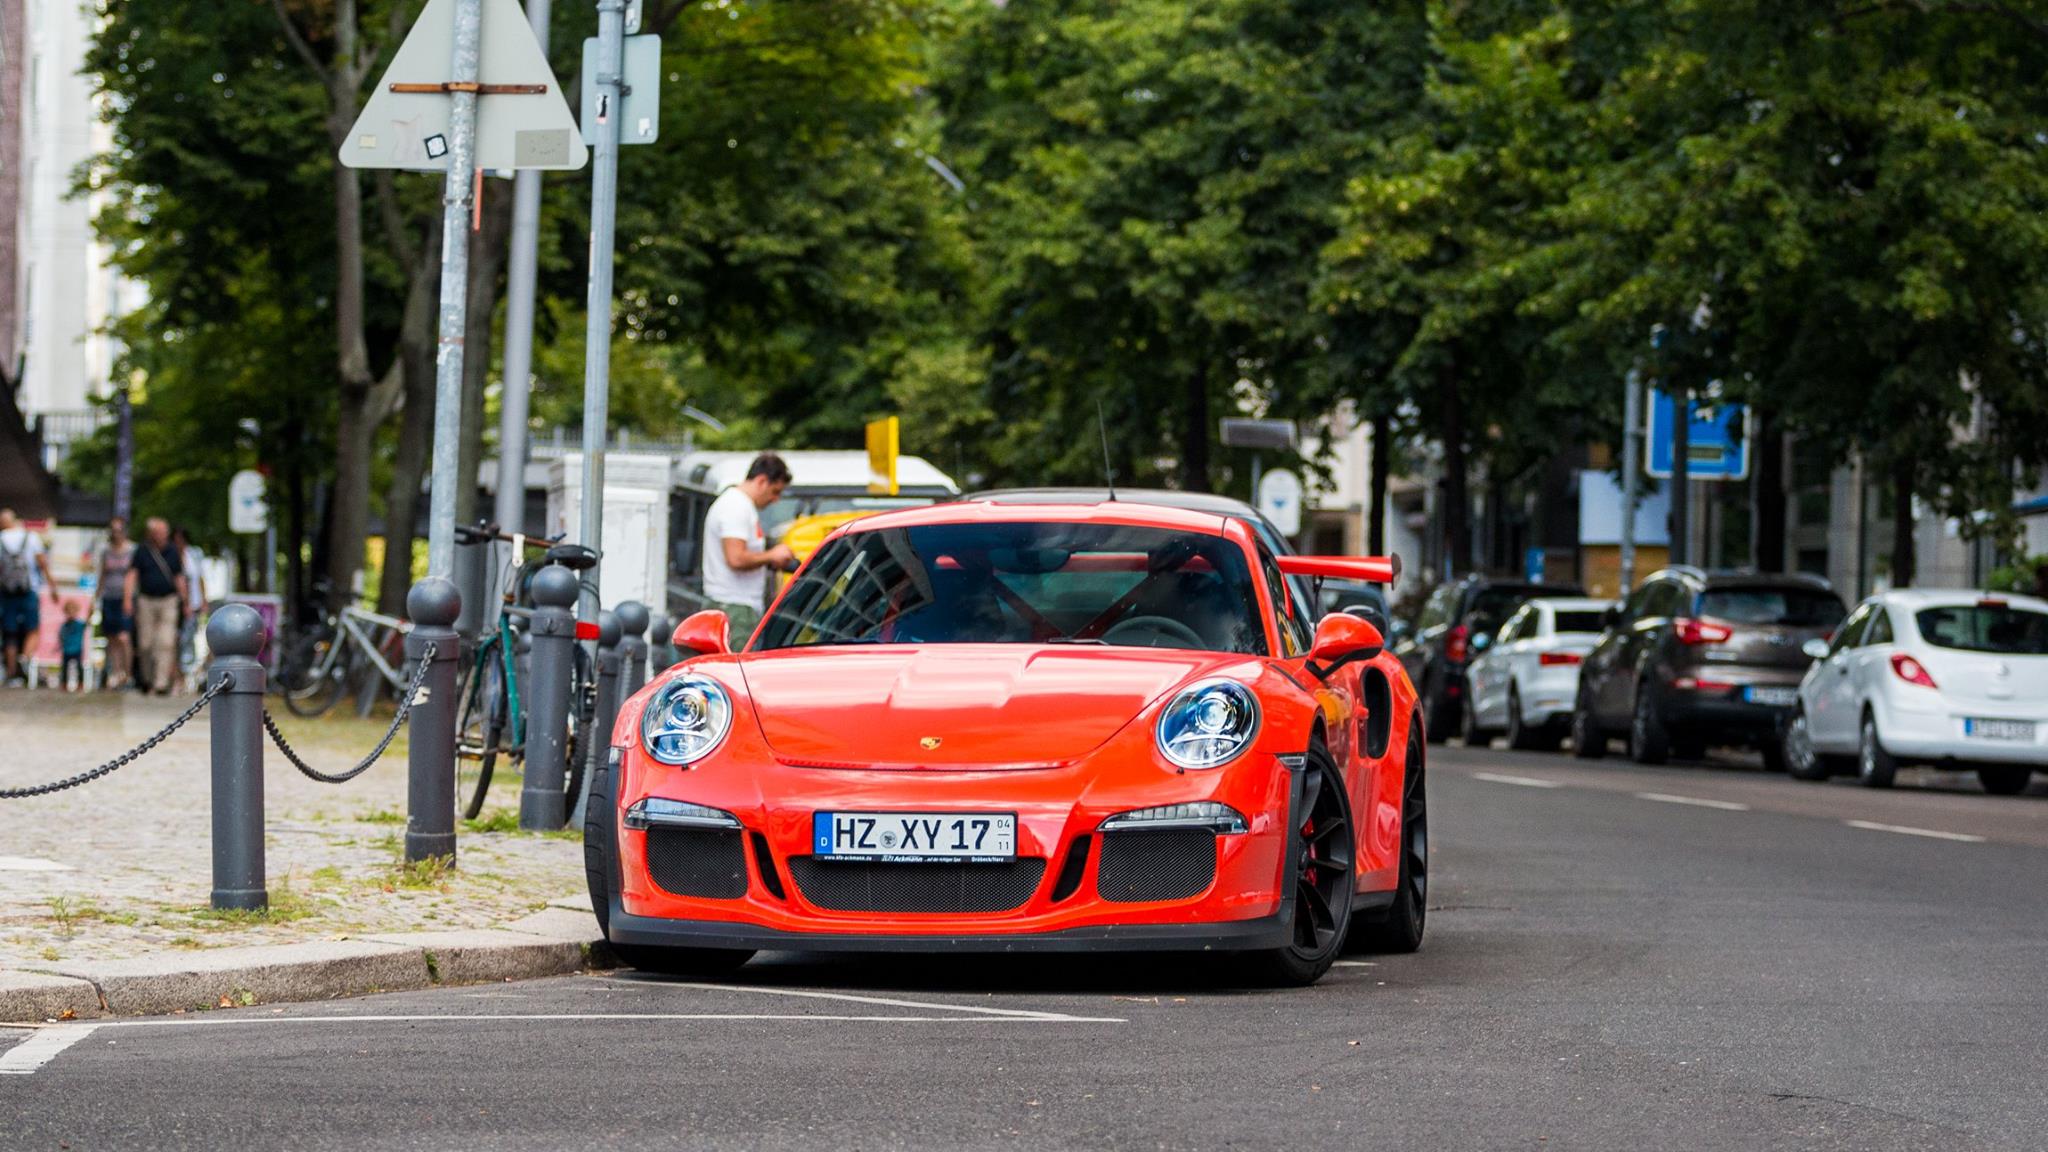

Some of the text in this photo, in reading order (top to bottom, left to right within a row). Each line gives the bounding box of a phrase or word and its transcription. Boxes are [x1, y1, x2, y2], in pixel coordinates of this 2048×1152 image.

[997, 819, 1010, 829] 04
[835, 818, 991, 850] HZ XY 17
[820, 836, 828, 847] D
[998, 841, 1010, 850] 11
